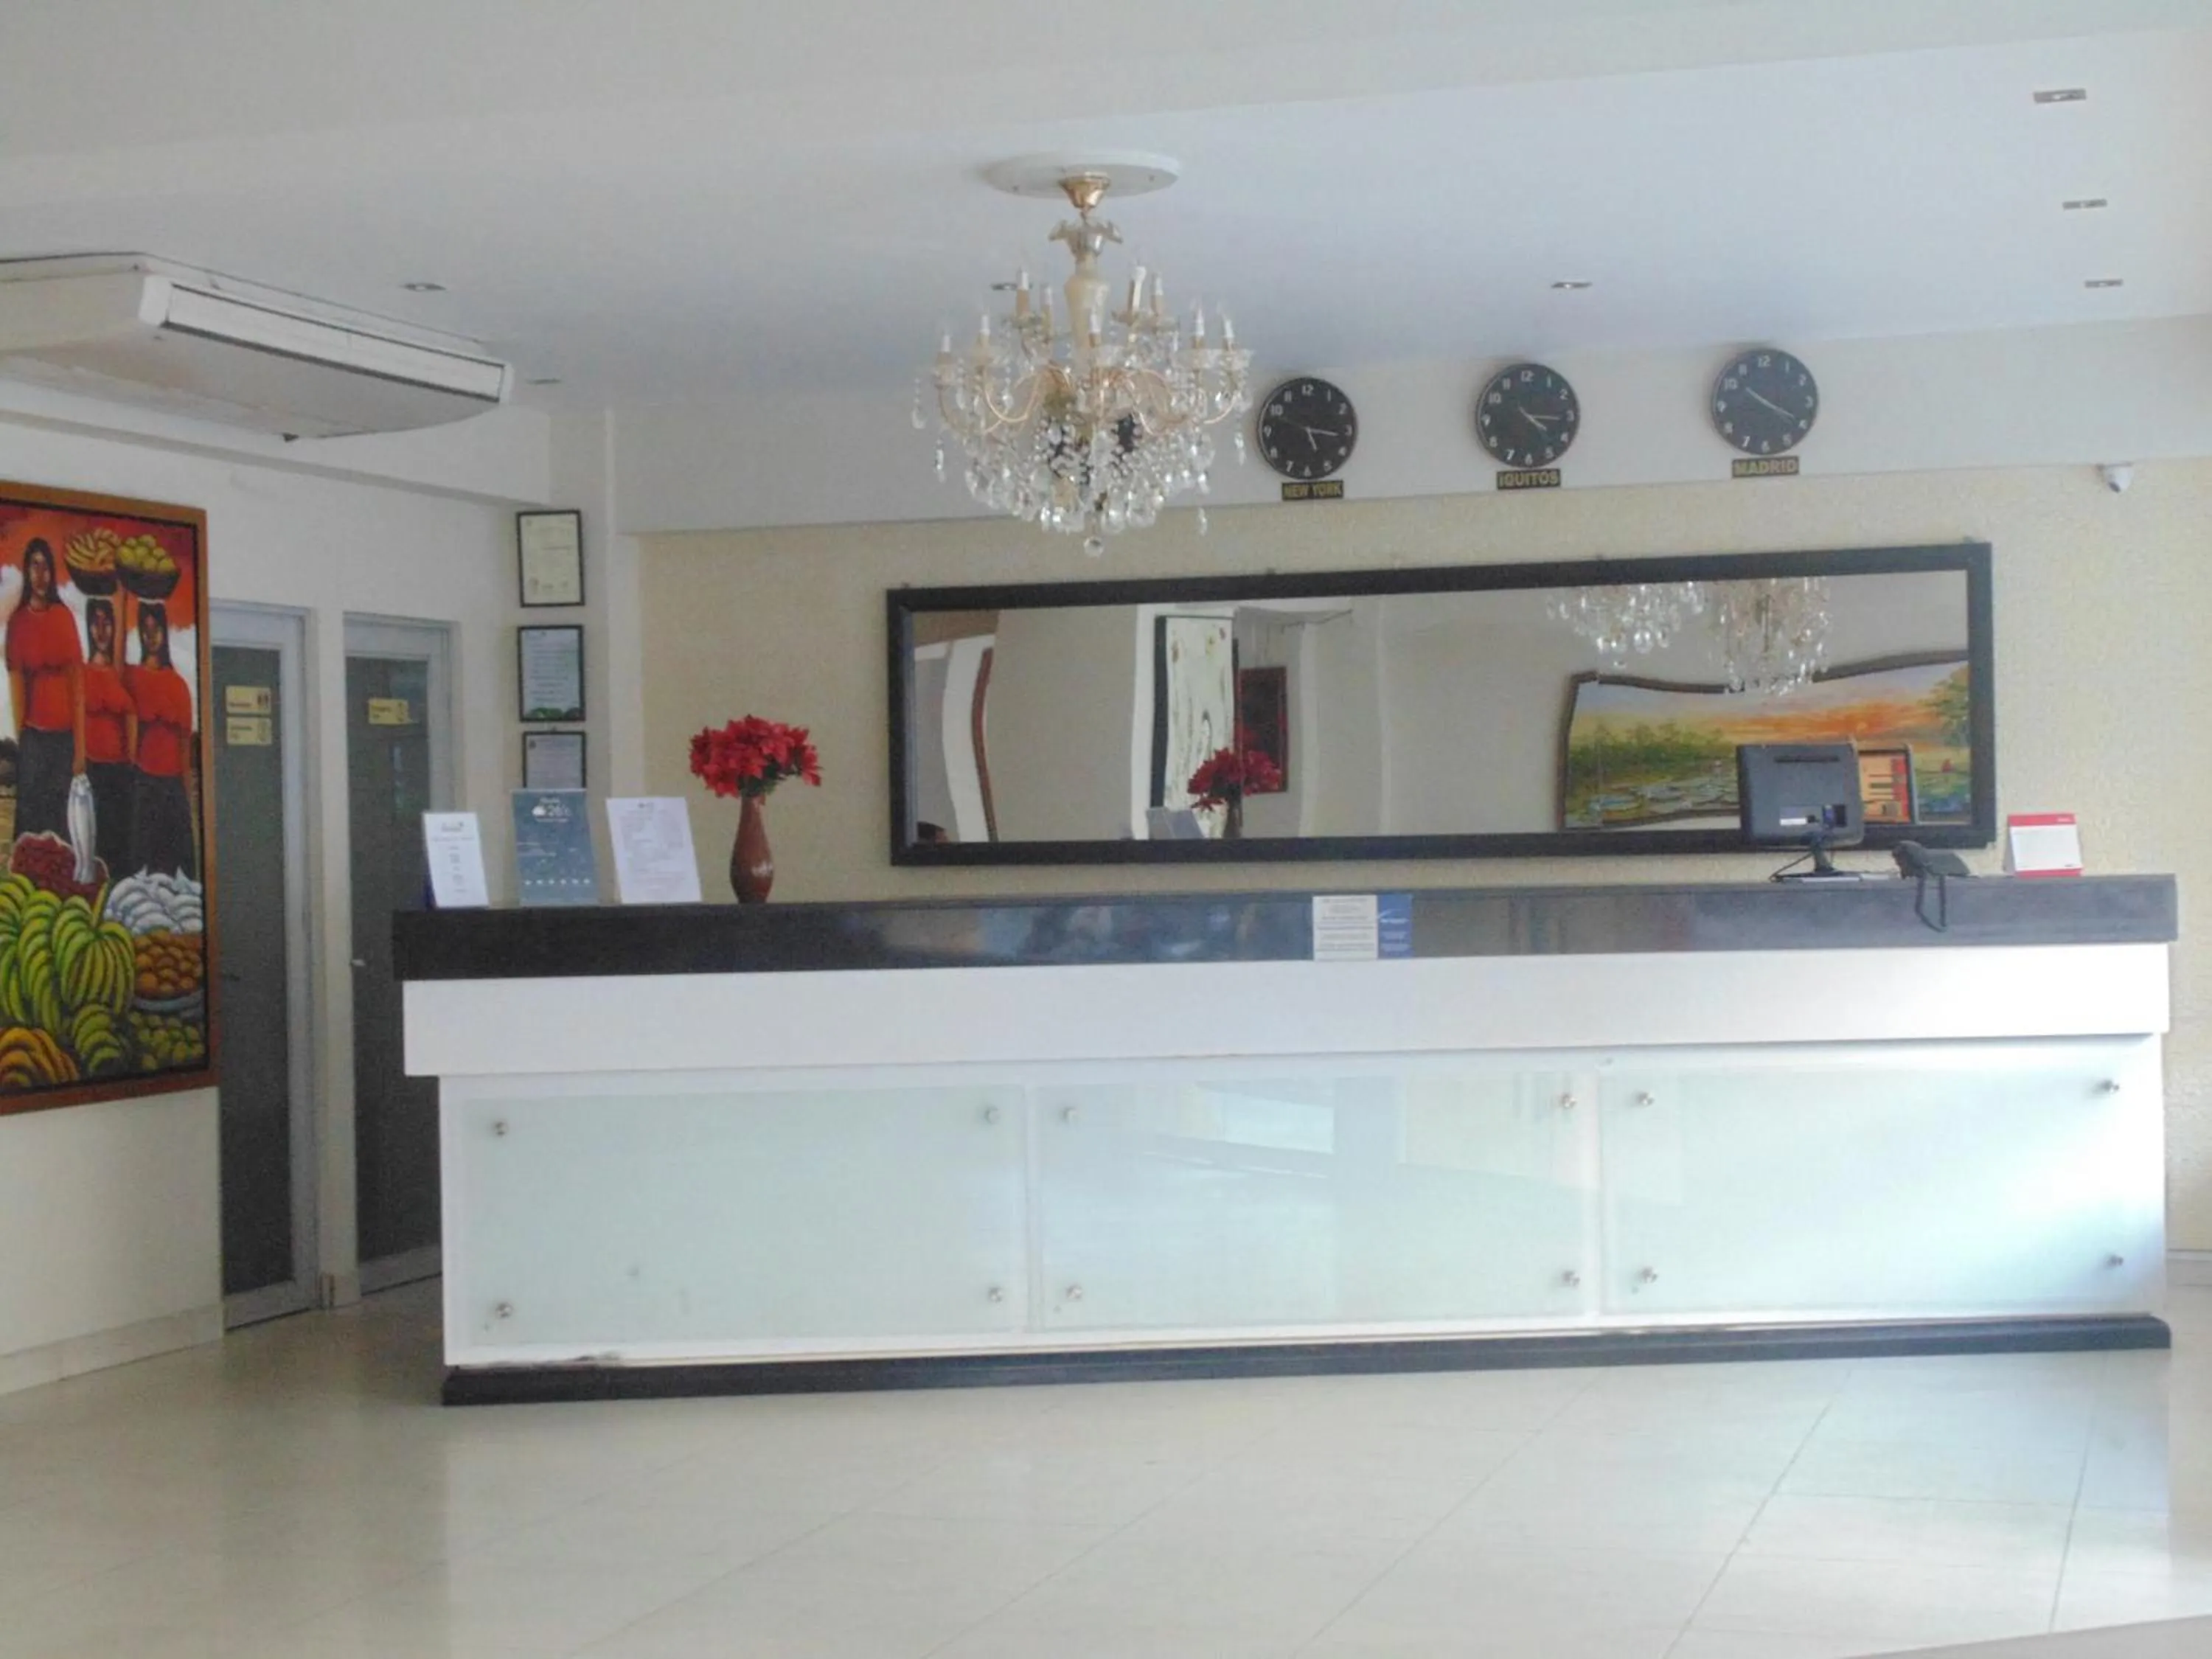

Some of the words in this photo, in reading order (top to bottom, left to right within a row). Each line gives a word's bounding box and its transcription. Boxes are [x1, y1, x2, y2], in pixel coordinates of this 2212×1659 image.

[1758, 355, 1770, 367] 12
[1785, 361, 1789, 373] 1
[1739, 364, 1747, 375] 11
[1521, 370, 1534, 382] 12
[1547, 375, 1551, 387] 1
[1798, 375, 1806, 386] 2
[1503, 378, 1511, 389] 11
[1724, 378, 1738, 390] 10
[1284, 390, 1292, 402] 11
[1301, 384, 1314, 396] 12
[1327, 389, 1331, 401] 1
[1559, 389, 1568, 400] 2
[1489, 392, 1501, 404] 10
[1805, 396, 1813, 408] 3
[1270, 404, 1283, 416] 10
[1339, 403, 1347, 415] 2
[1717, 400, 1726, 413] 9
[1482, 414, 1490, 426] 9
[1566, 410, 1574, 422] 3
[1264, 425, 1272, 437] 9
[1345, 425, 1352, 437] 3
[1798, 420, 1807, 430] 4
[1560, 432, 1568, 442] 4
[1742, 436, 1750, 448] 7
[1783, 434, 1792, 445] 5
[1338, 446, 1346, 456] 4
[1761, 440, 1770, 452] 6
[1506, 448, 1514, 461] 7
[1545, 446, 1554, 459] 5
[1525, 453, 1533, 465] 6
[1287, 461, 1294, 473] 7
[1304, 465, 1312, 476] 6
[1324, 461, 1332, 472] 5
[1735, 459, 1796, 473] MADRID
[1499, 472, 1558, 486] IQUITOS
[1286, 484, 1309, 497] NEW
[1313, 484, 1341, 496] YORK
